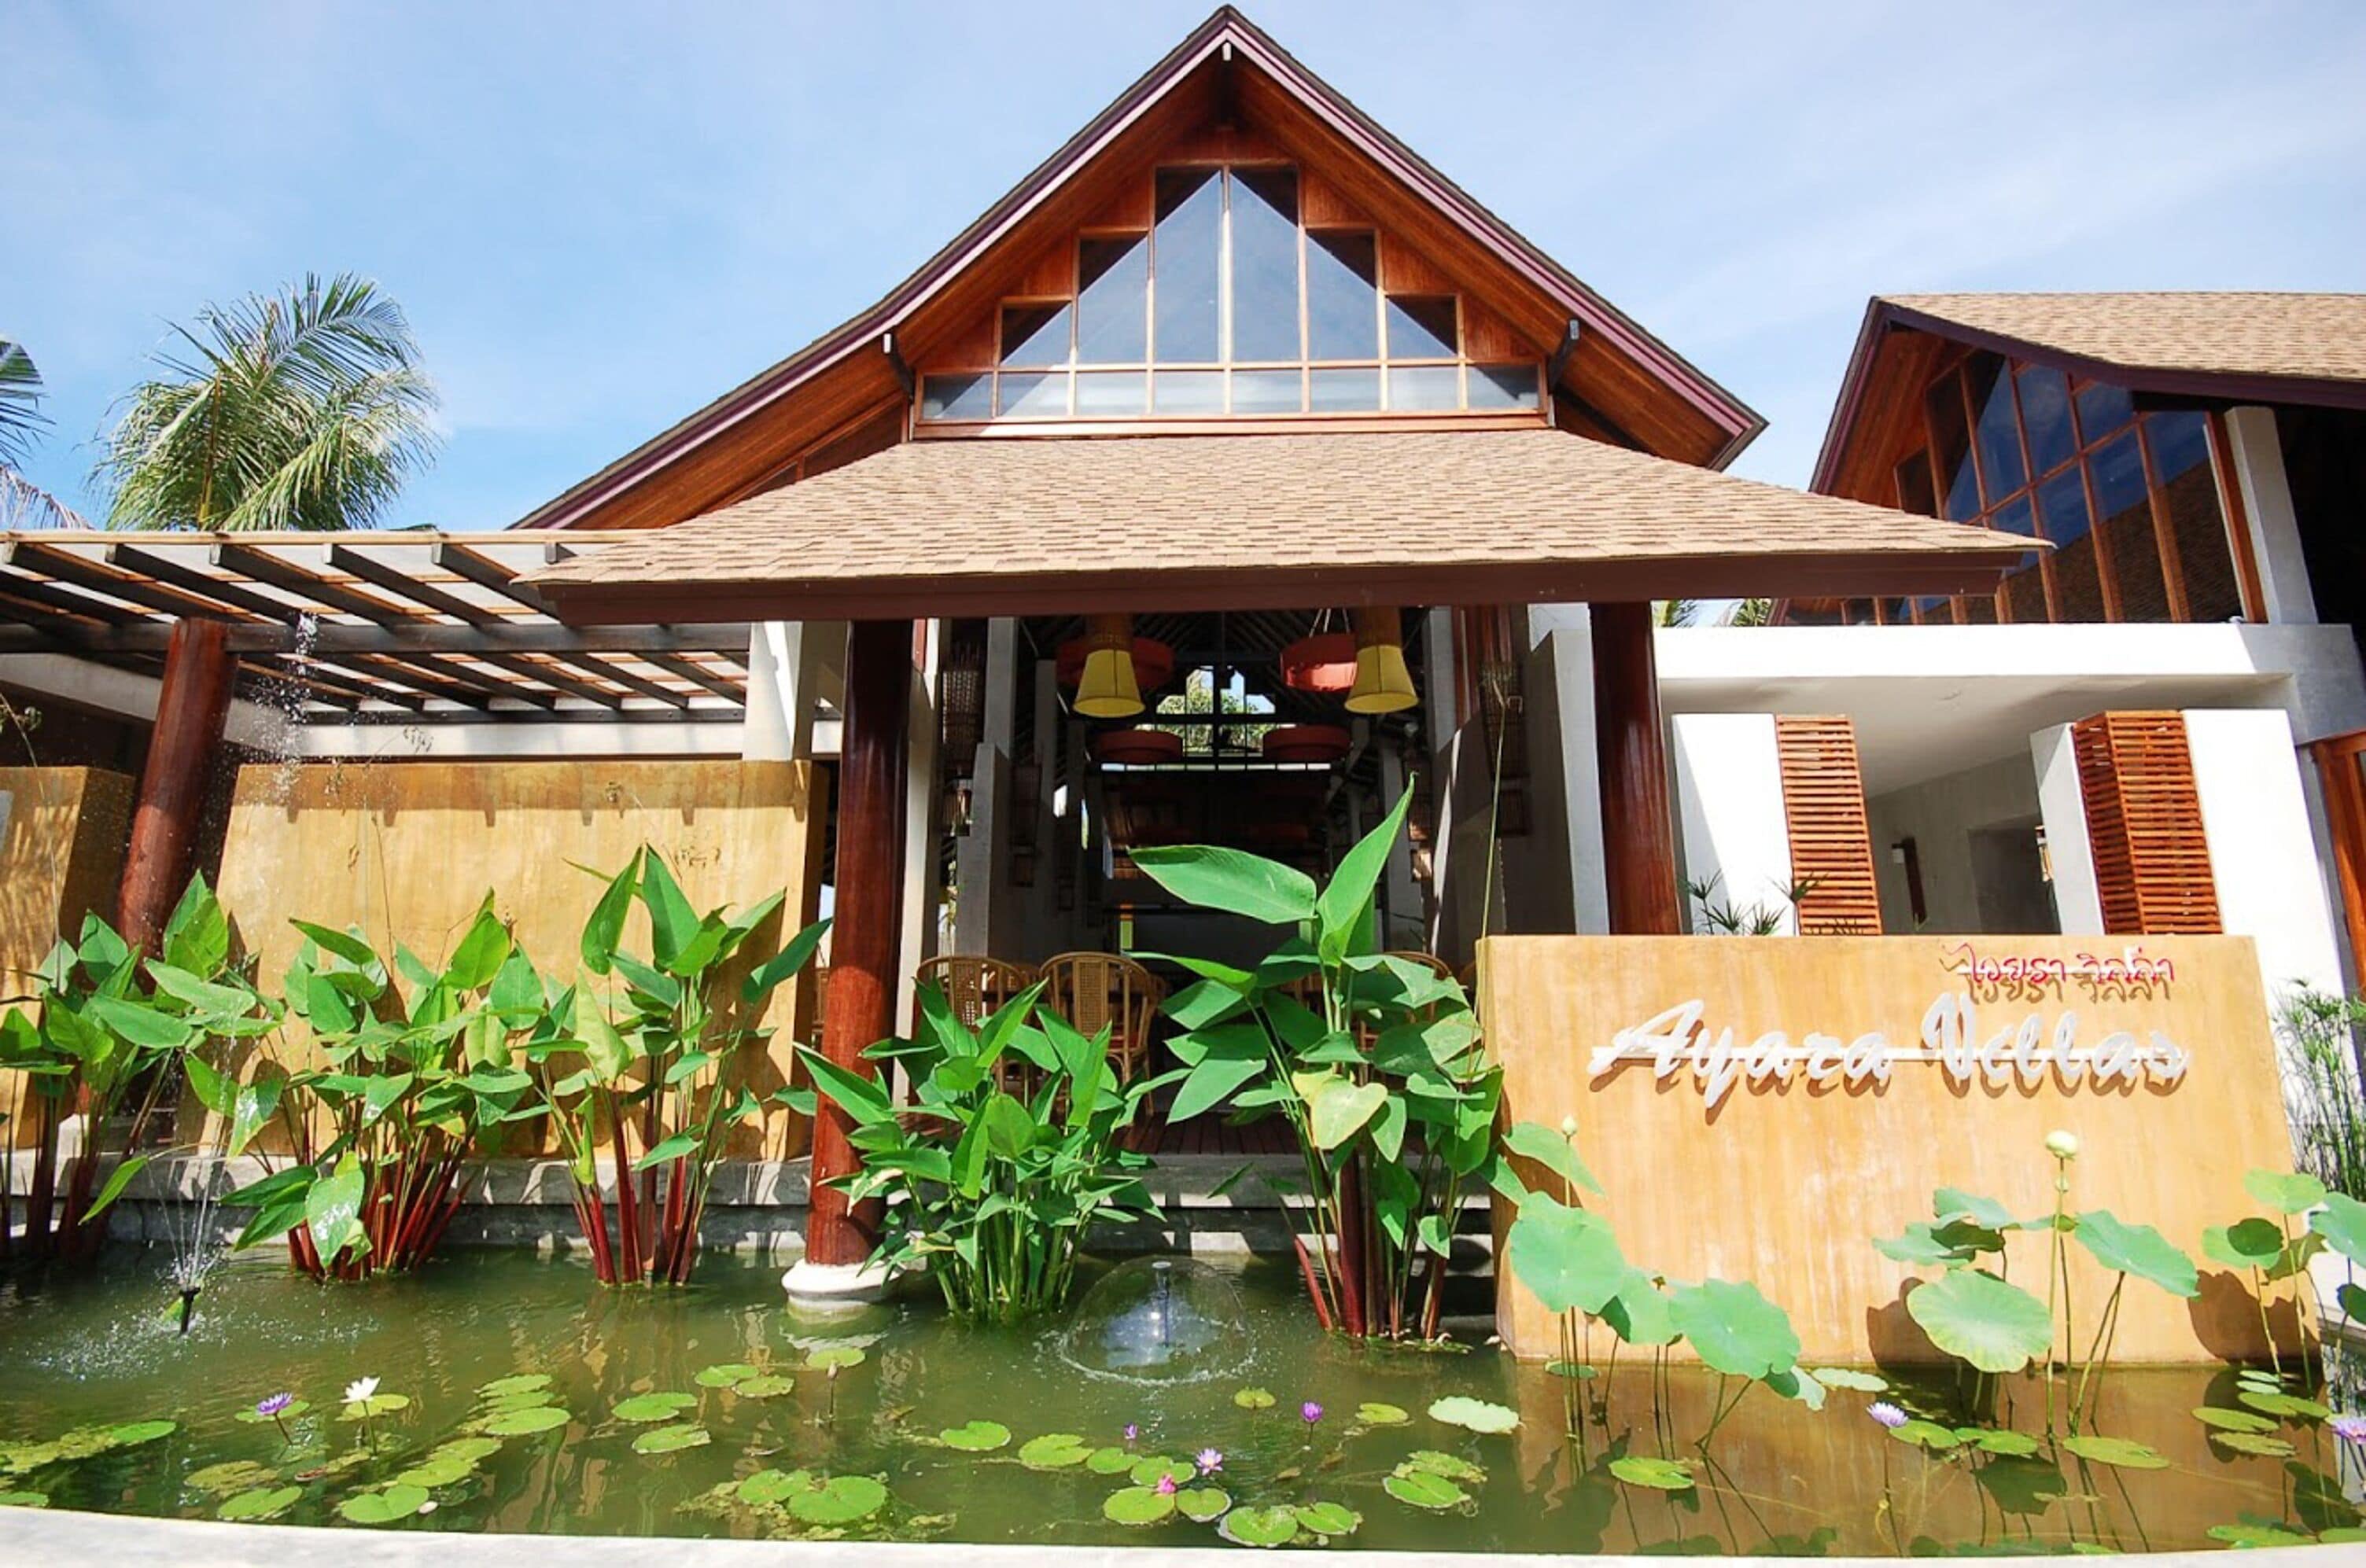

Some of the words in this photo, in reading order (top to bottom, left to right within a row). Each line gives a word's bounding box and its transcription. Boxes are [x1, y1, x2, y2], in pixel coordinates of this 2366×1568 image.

[1943, 943, 2066, 983] ไอยรา
[1587, 999, 1893, 1109] Ayara
[1921, 992, 2192, 1080] Villas
